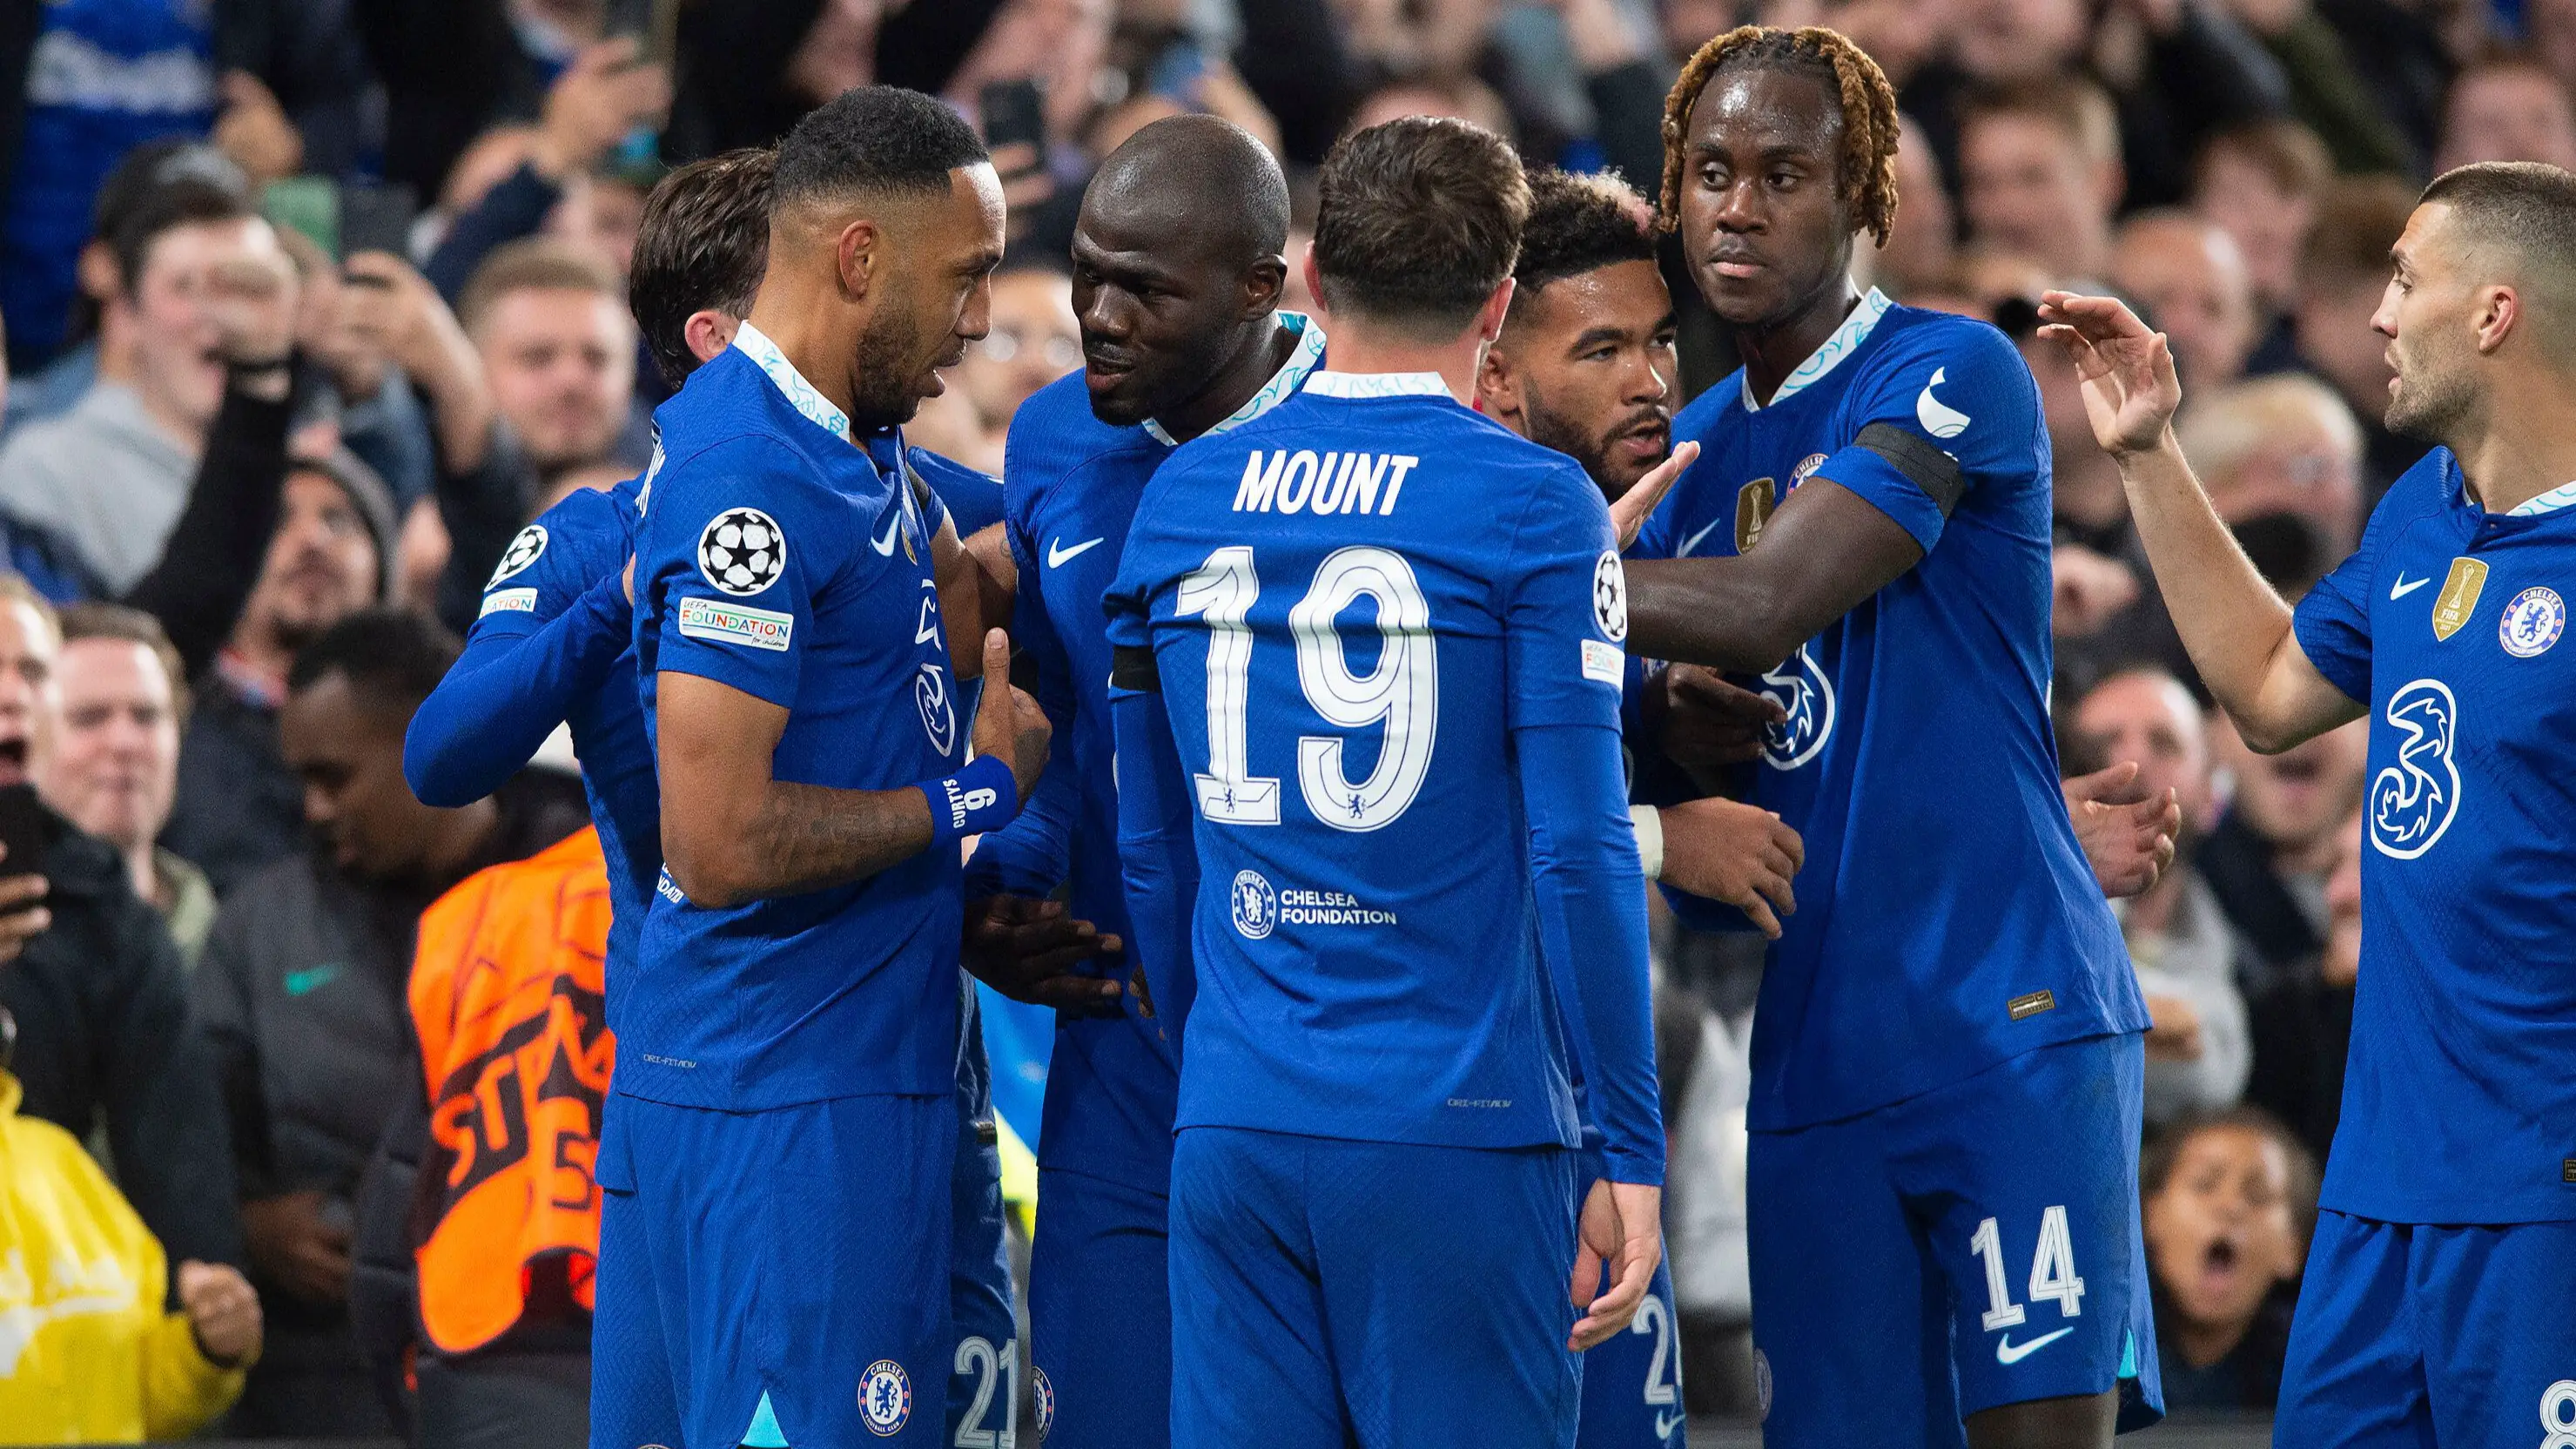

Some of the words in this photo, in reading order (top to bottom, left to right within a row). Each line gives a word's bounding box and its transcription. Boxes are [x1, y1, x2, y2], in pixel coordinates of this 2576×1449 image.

[1794, 456, 1824, 479] CHELSE
[1233, 449, 1417, 516] MOUNT
[683, 601, 707, 610] UEFA
[2522, 590, 2561, 610] CHELSEA
[683, 610, 788, 637] FOUNDATION
[2440, 609, 2460, 621] FIFA
[1174, 545, 1438, 832] 19
[942, 778, 966, 829] CURTYS
[964, 787, 997, 811] 9
[1281, 890, 1359, 907] CHELSEA
[1281, 908, 1397, 925] FOUNDATION
[1971, 1205, 2086, 1332] 14
[871, 1362, 905, 1384] CHELSEA
[954, 1336, 1018, 1448] 21
